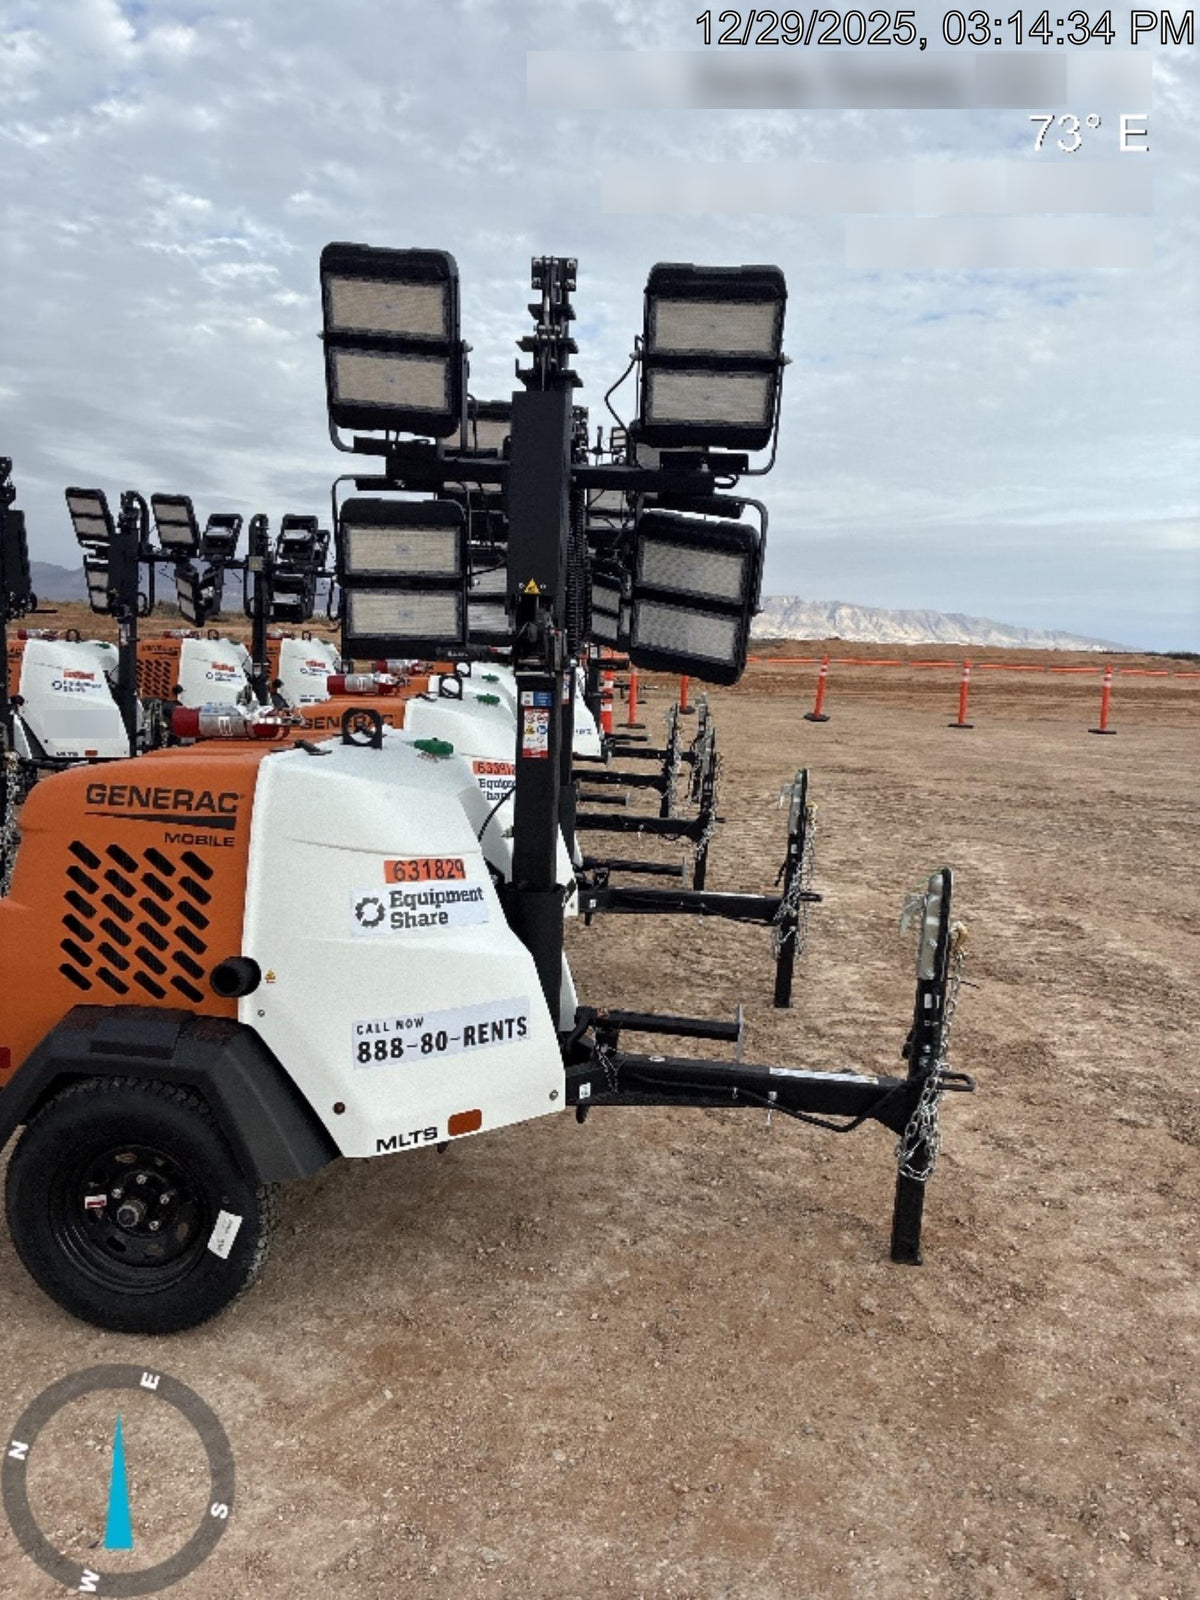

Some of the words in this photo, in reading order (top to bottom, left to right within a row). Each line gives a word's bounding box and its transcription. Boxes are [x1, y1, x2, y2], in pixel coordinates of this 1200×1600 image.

[86, 783, 240, 814] GENERAC
[164, 832, 236, 848] MOBILE
[393, 859, 466, 881] 631829
[389, 887, 485, 911] Equipment
[390, 910, 449, 930] Share
[356, 1023, 390, 1036] CALL
[395, 1016, 424, 1031] NOW
[357, 1016, 528, 1063] 888-80-RENTS
[376, 1126, 439, 1153] MLTS
